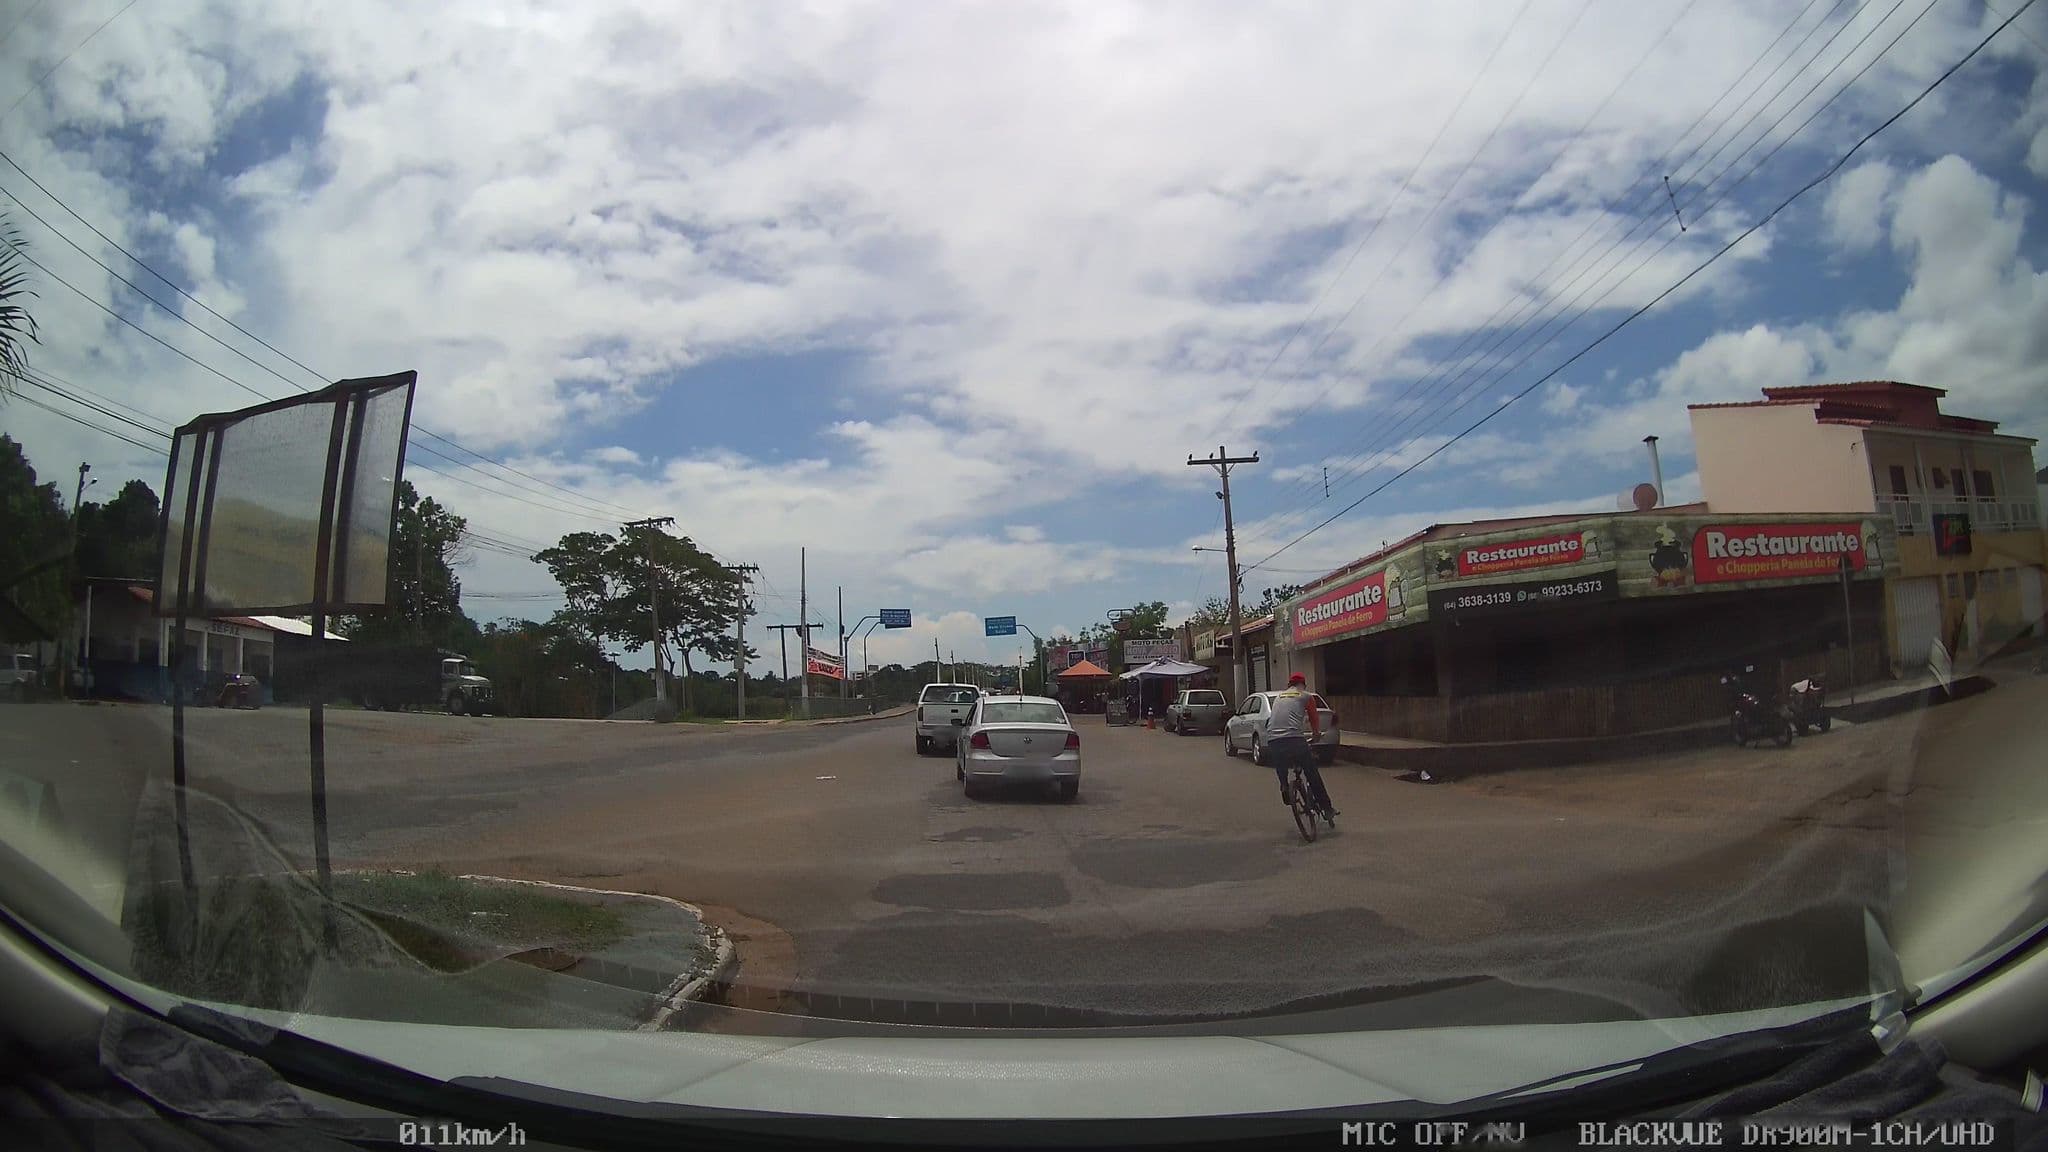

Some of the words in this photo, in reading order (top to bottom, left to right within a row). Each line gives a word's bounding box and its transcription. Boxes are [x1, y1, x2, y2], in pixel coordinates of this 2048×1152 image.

[1467, 538, 1578, 564] Restaurante
[1706, 531, 1859, 559] Restaurante
[1458, 591, 1511, 608] 3638-3139
[1542, 580, 1602, 597] 99233-6373
[1298, 585, 1382, 626] Restaurante
